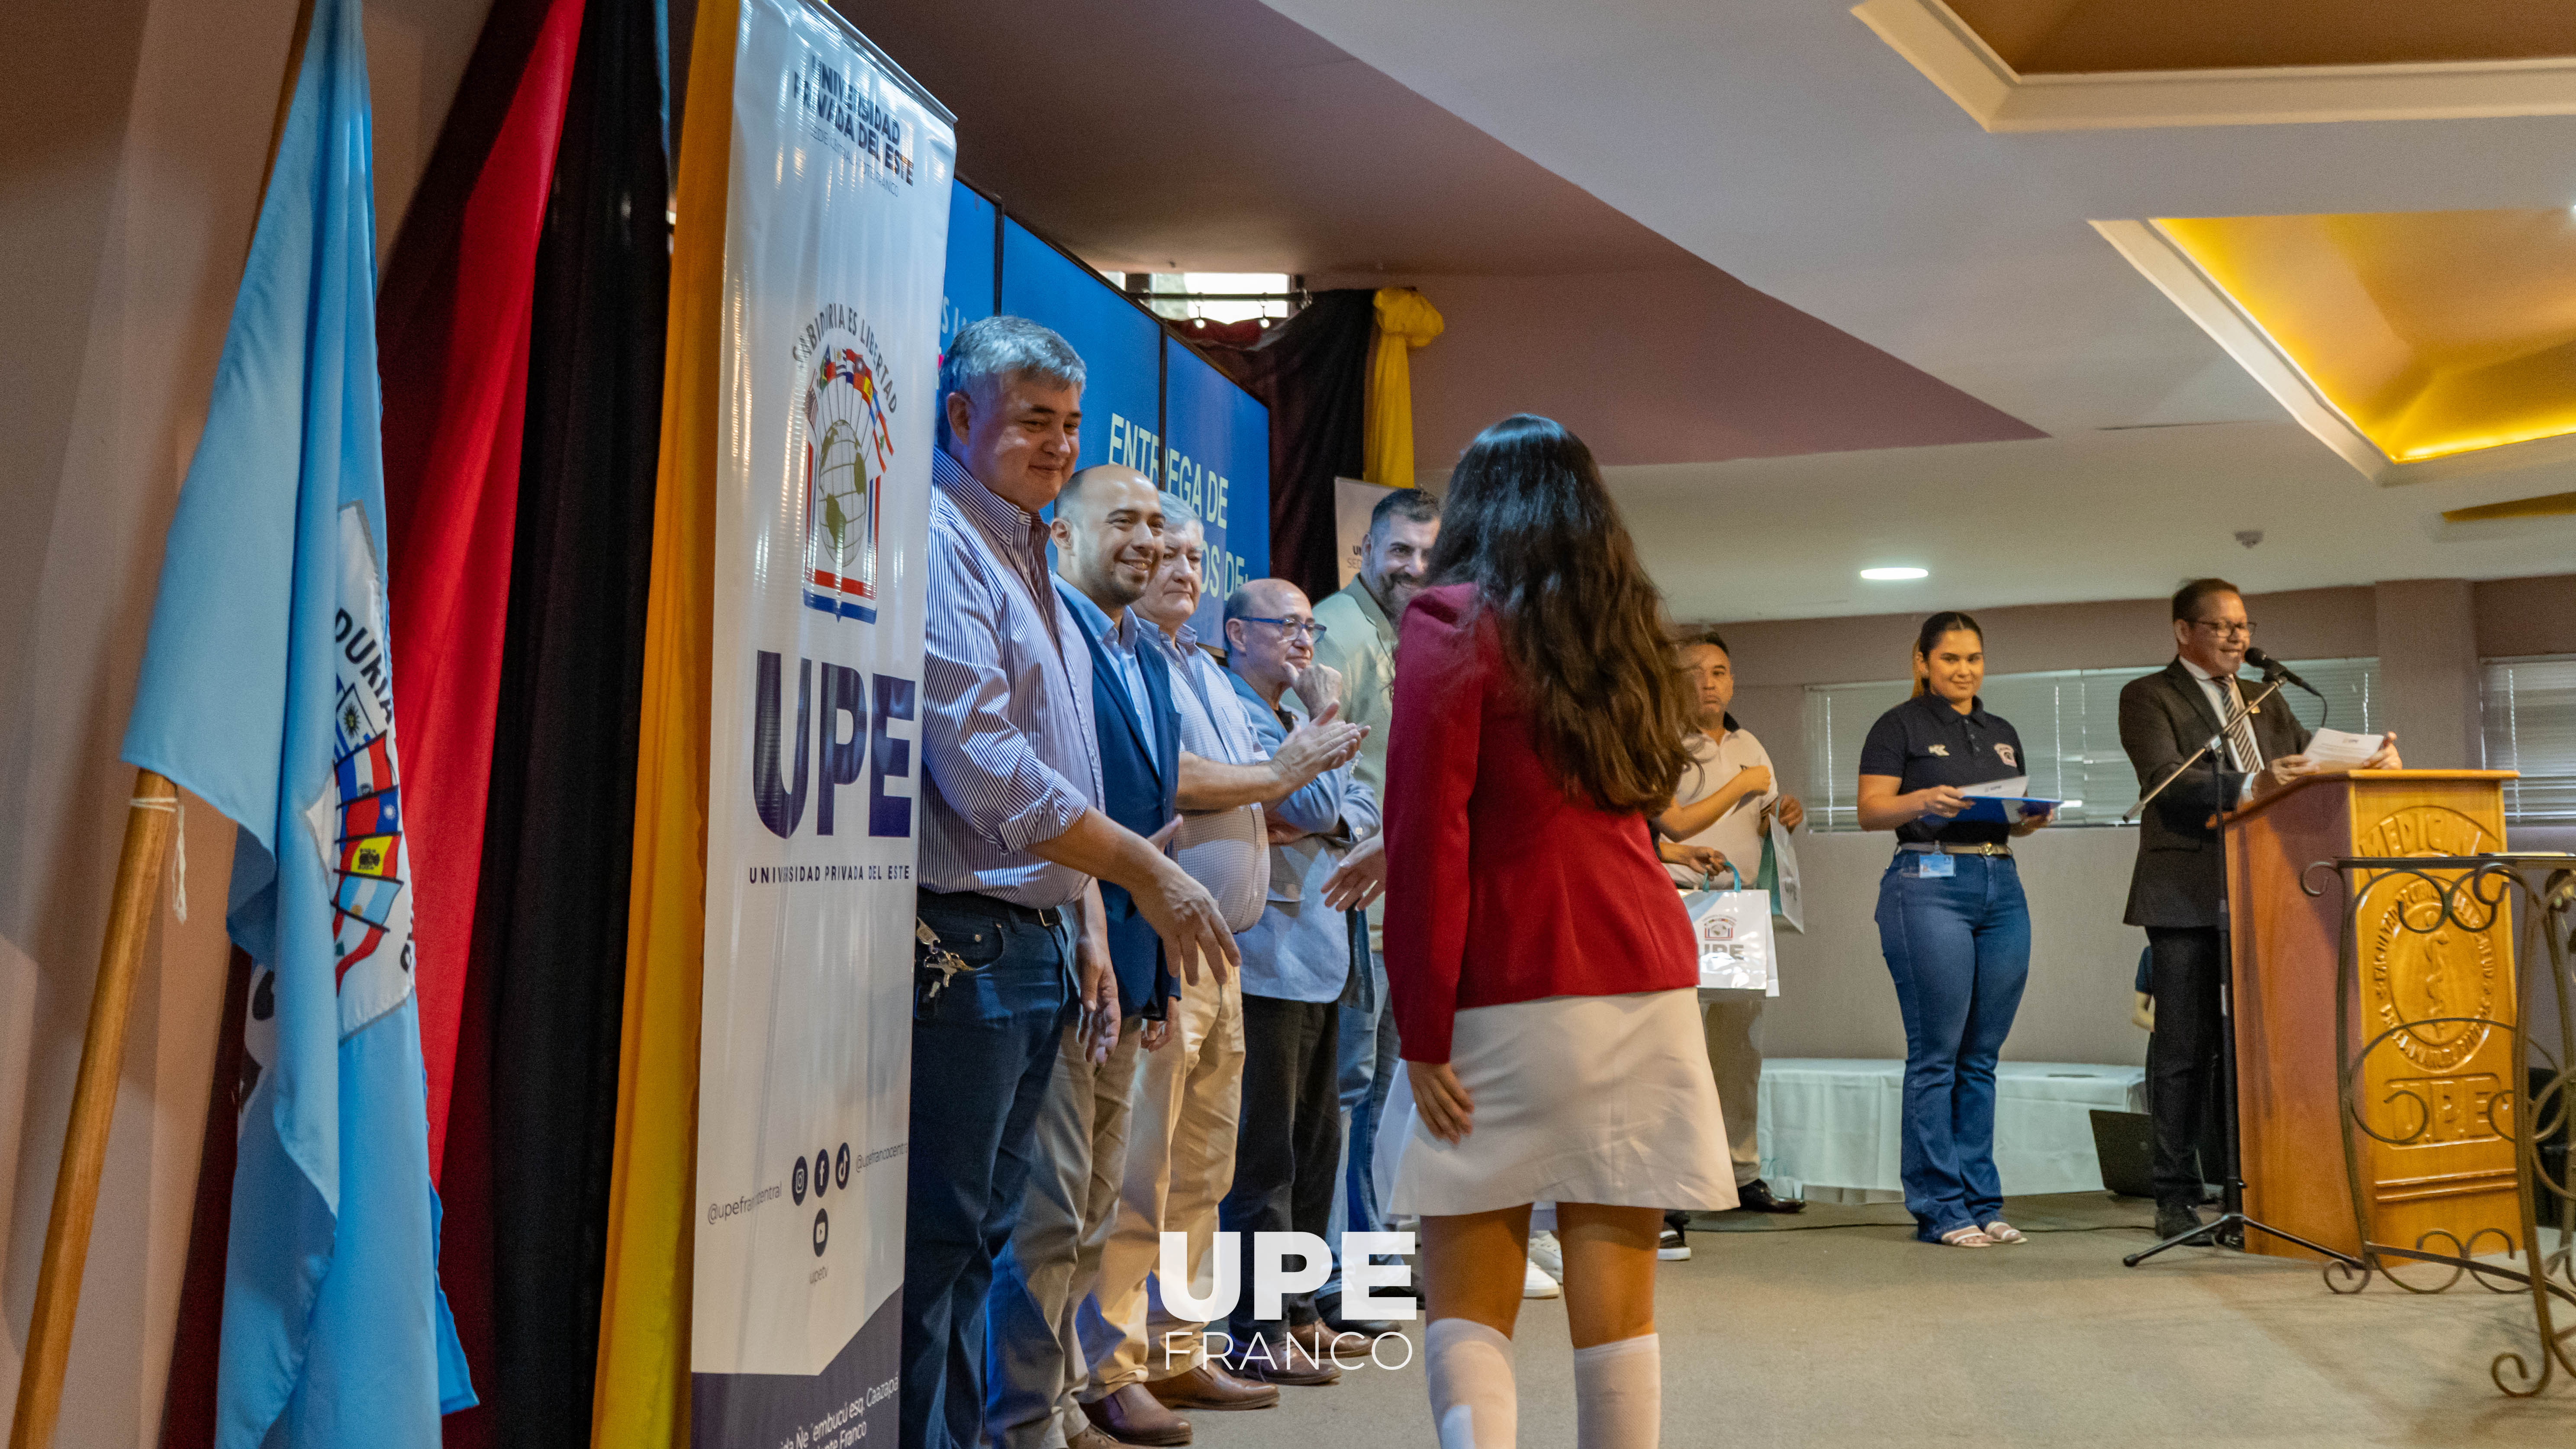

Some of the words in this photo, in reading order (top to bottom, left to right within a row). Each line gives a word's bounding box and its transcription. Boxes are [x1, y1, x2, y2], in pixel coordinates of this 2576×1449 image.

[858, 121, 881, 162] DEL
[885, 142, 914, 187] ESTE
[848, 306, 858, 336] ES
[860, 318, 897, 413] LIBERTAD
[1207, 470, 1229, 530] DE
[1201, 539, 1220, 598] OS
[753, 650, 916, 840] UPE
[825, 866, 864, 881] PRIVADA
[869, 865, 882, 880] DEL
[888, 866, 909, 880] ESTE
[866, 1371, 899, 1407] Caazapá
[840, 1421, 867, 1449] Franco
